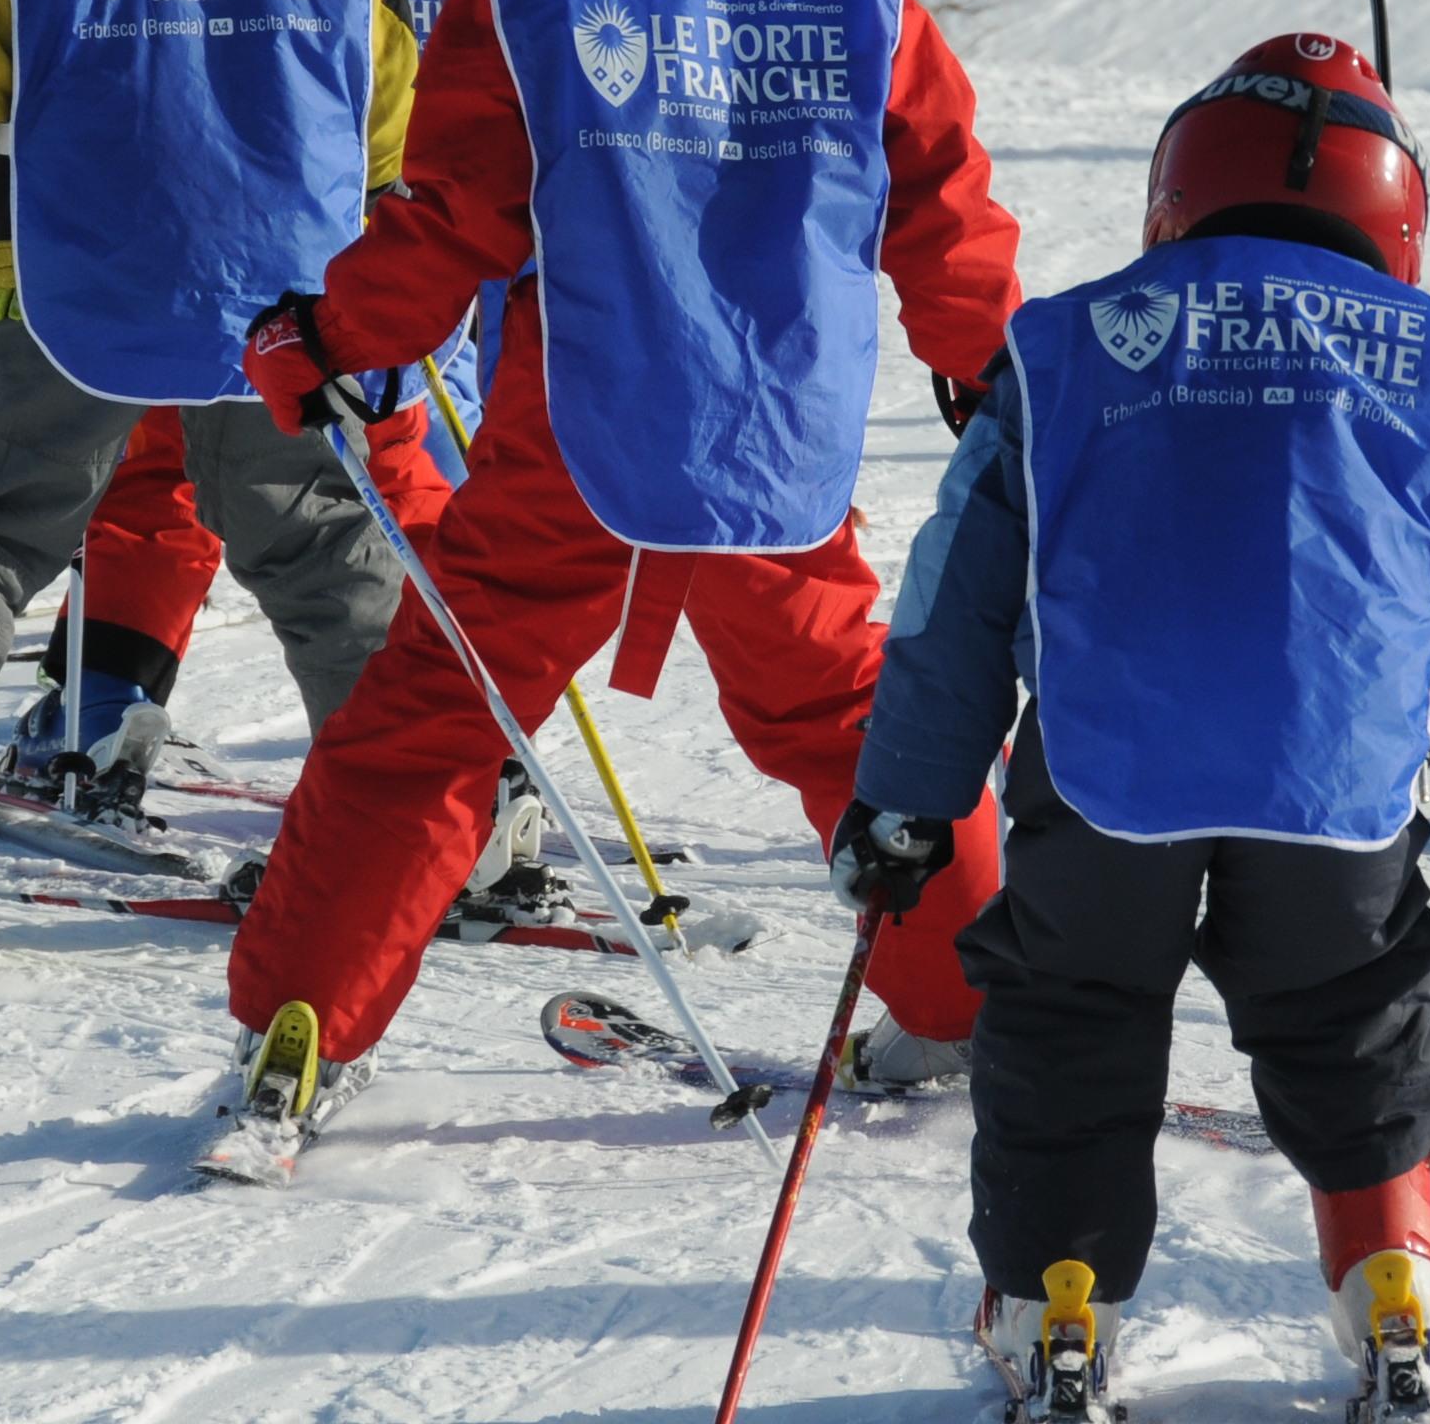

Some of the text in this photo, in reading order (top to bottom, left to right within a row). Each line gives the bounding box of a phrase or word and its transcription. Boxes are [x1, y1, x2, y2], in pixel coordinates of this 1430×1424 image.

[758, 0, 768, 12] &
[769, 0, 843, 15] divertimento
[79, 13, 331, 40] Erbusco (Brescia) A4 uscita Rovato
[650, 14, 848, 63] LE PORTE
[652, 52, 851, 105] FRANCHE
[1201, 75, 1313, 112] uvex
[658, 99, 854, 125] BOTTEGHE IN FRANCIACORTA
[579, 129, 853, 159] Erbusco (Brescia) A4 uscita Rovato
[1185, 282, 1427, 343] LE PORTE
[1185, 311, 1423, 387] FRANCHE
[1185, 354, 1281, 371] BOTTEGHE
[1286, 356, 1303, 371] IN
[1168, 385, 1253, 407] (Brescia)
[1267, 389, 1290, 403] A4
[1303, 387, 1354, 413] uscita
